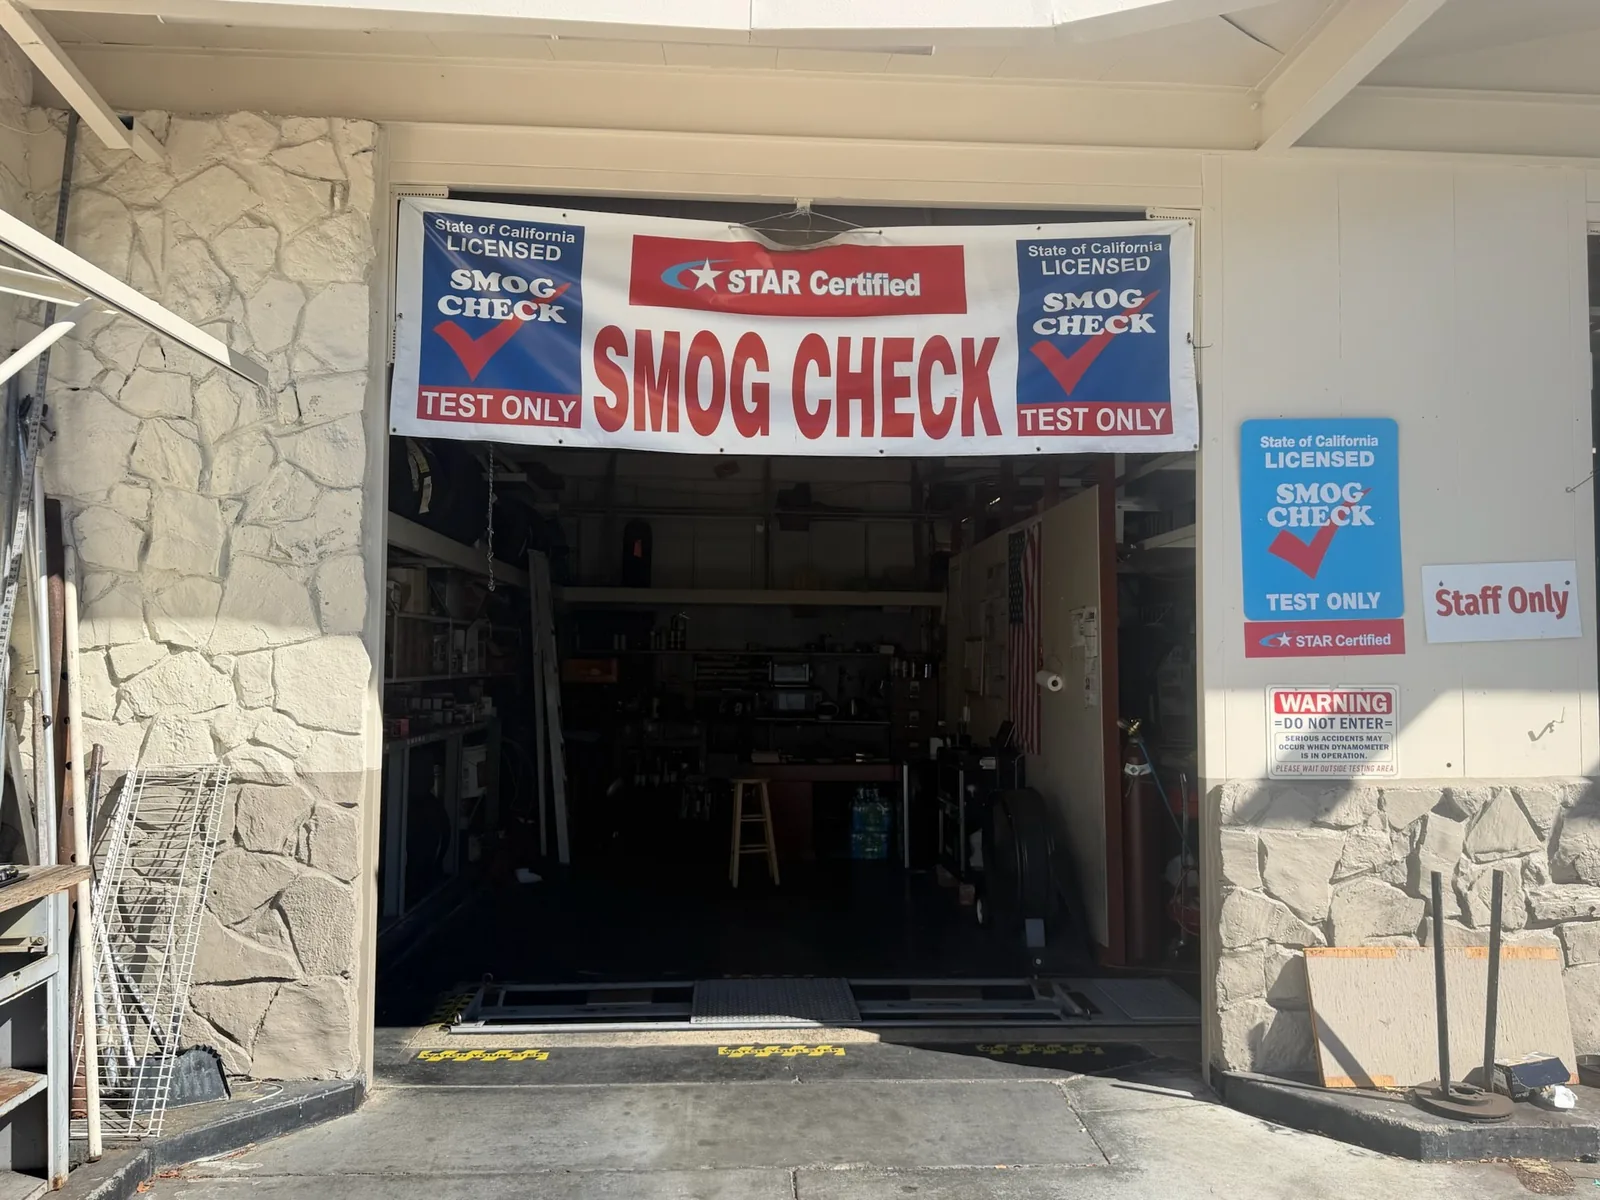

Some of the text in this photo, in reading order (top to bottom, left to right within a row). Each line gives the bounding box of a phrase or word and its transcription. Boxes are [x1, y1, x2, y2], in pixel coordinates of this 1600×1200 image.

[435, 218, 575, 243] State of California
[447, 236, 561, 261] LICENSED
[1028, 241, 1162, 257] State of California
[1041, 256, 1150, 275] LICENSED
[450, 269, 556, 298] SMOG
[727, 269, 921, 296] STAR Certified
[438, 295, 567, 323] CHECK
[1043, 288, 1145, 312] SMOG
[1033, 313, 1156, 335] CHECK
[593, 324, 1003, 440] SMOG CHECK
[421, 391, 577, 422] TEST ONLY
[1020, 407, 1166, 431] TEST ONLY
[1260, 434, 1379, 448] State of California
[1265, 451, 1374, 468] LICENSED
[1277, 482, 1364, 504] SMOG
[1267, 505, 1375, 527] CHECK
[1266, 592, 1381, 611] TEST ONLY
[1435, 583, 1569, 620] Staff Only
[1296, 633, 1391, 647] STAR Certified
[1279, 693, 1387, 712] WARNING
[1284, 717, 1384, 729] DO NOT ENTER
